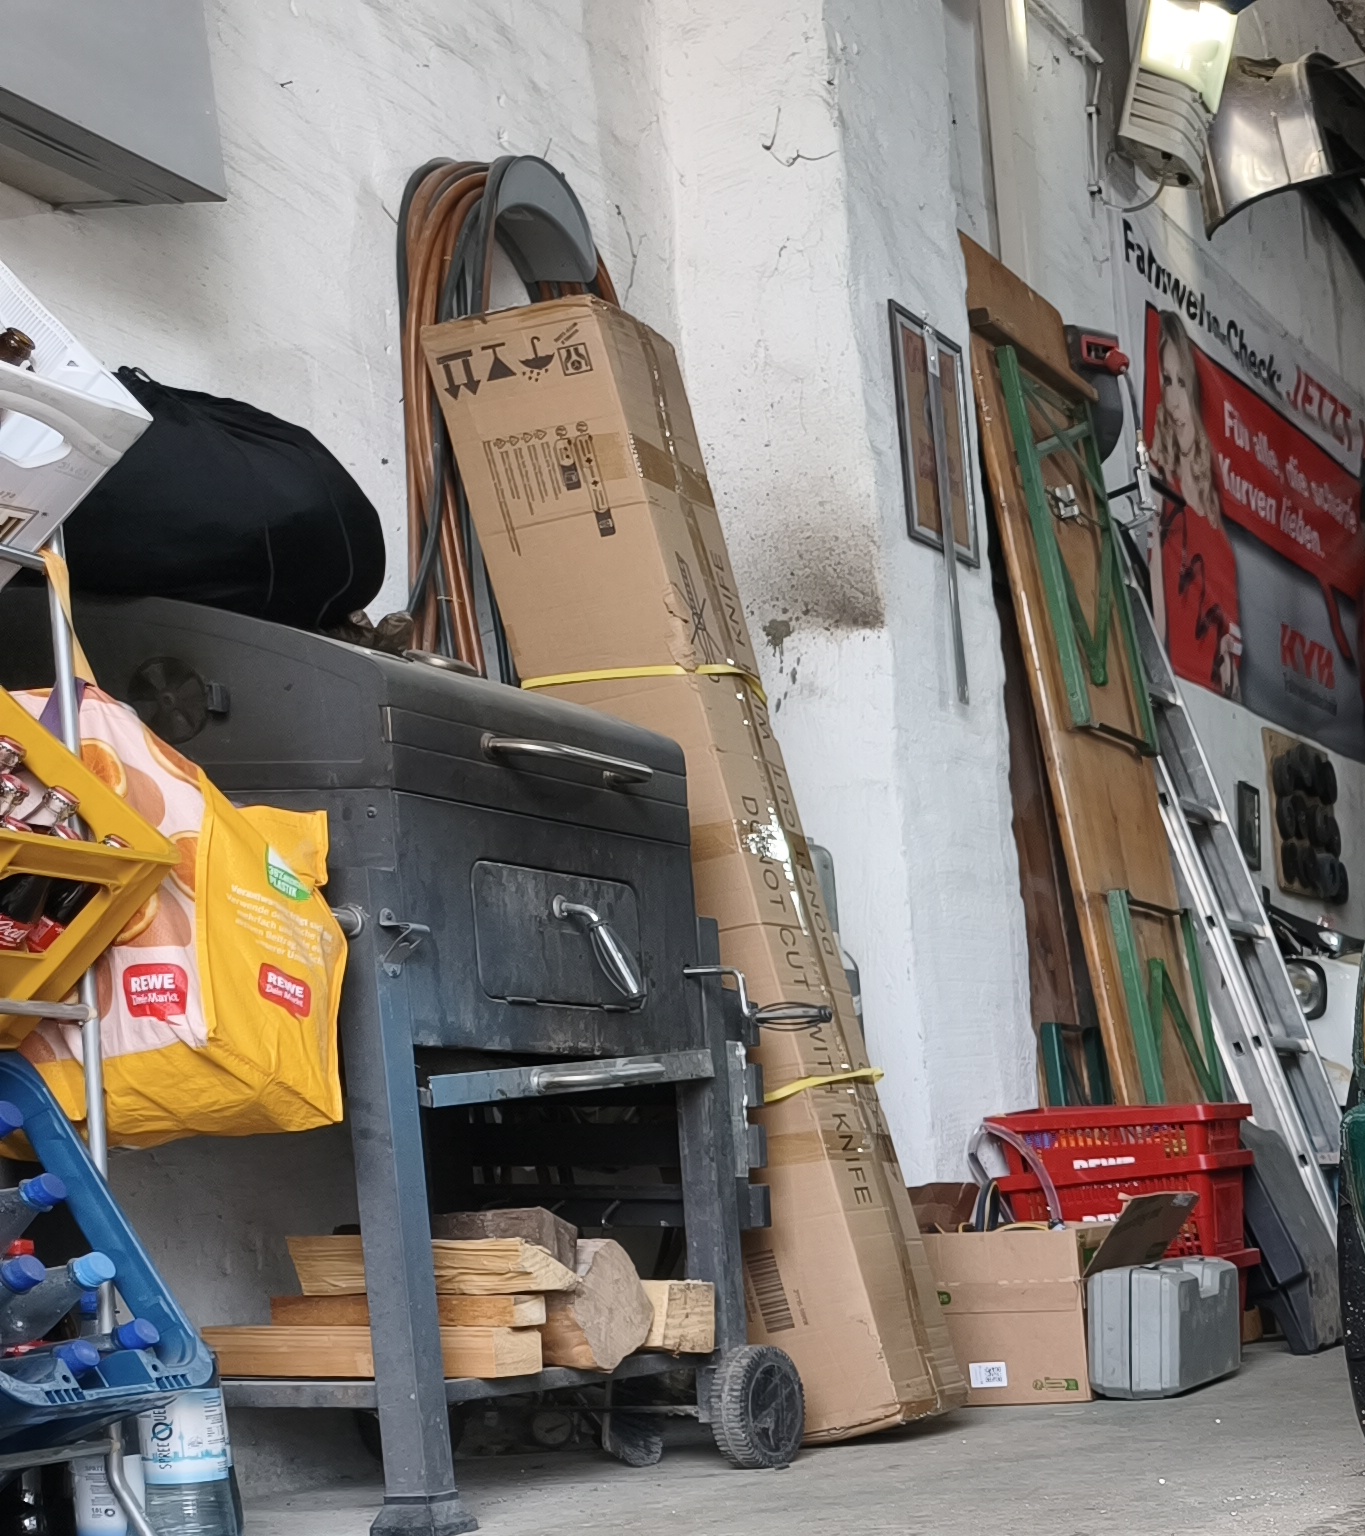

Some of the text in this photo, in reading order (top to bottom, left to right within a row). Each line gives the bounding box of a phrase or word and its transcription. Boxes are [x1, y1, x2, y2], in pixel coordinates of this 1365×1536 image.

[130, 973, 176, 993] REWE
[267, 970, 304, 999] REWE
[778, 927, 812, 992] CUT
[831, 1112, 874, 1206] KNIFE
